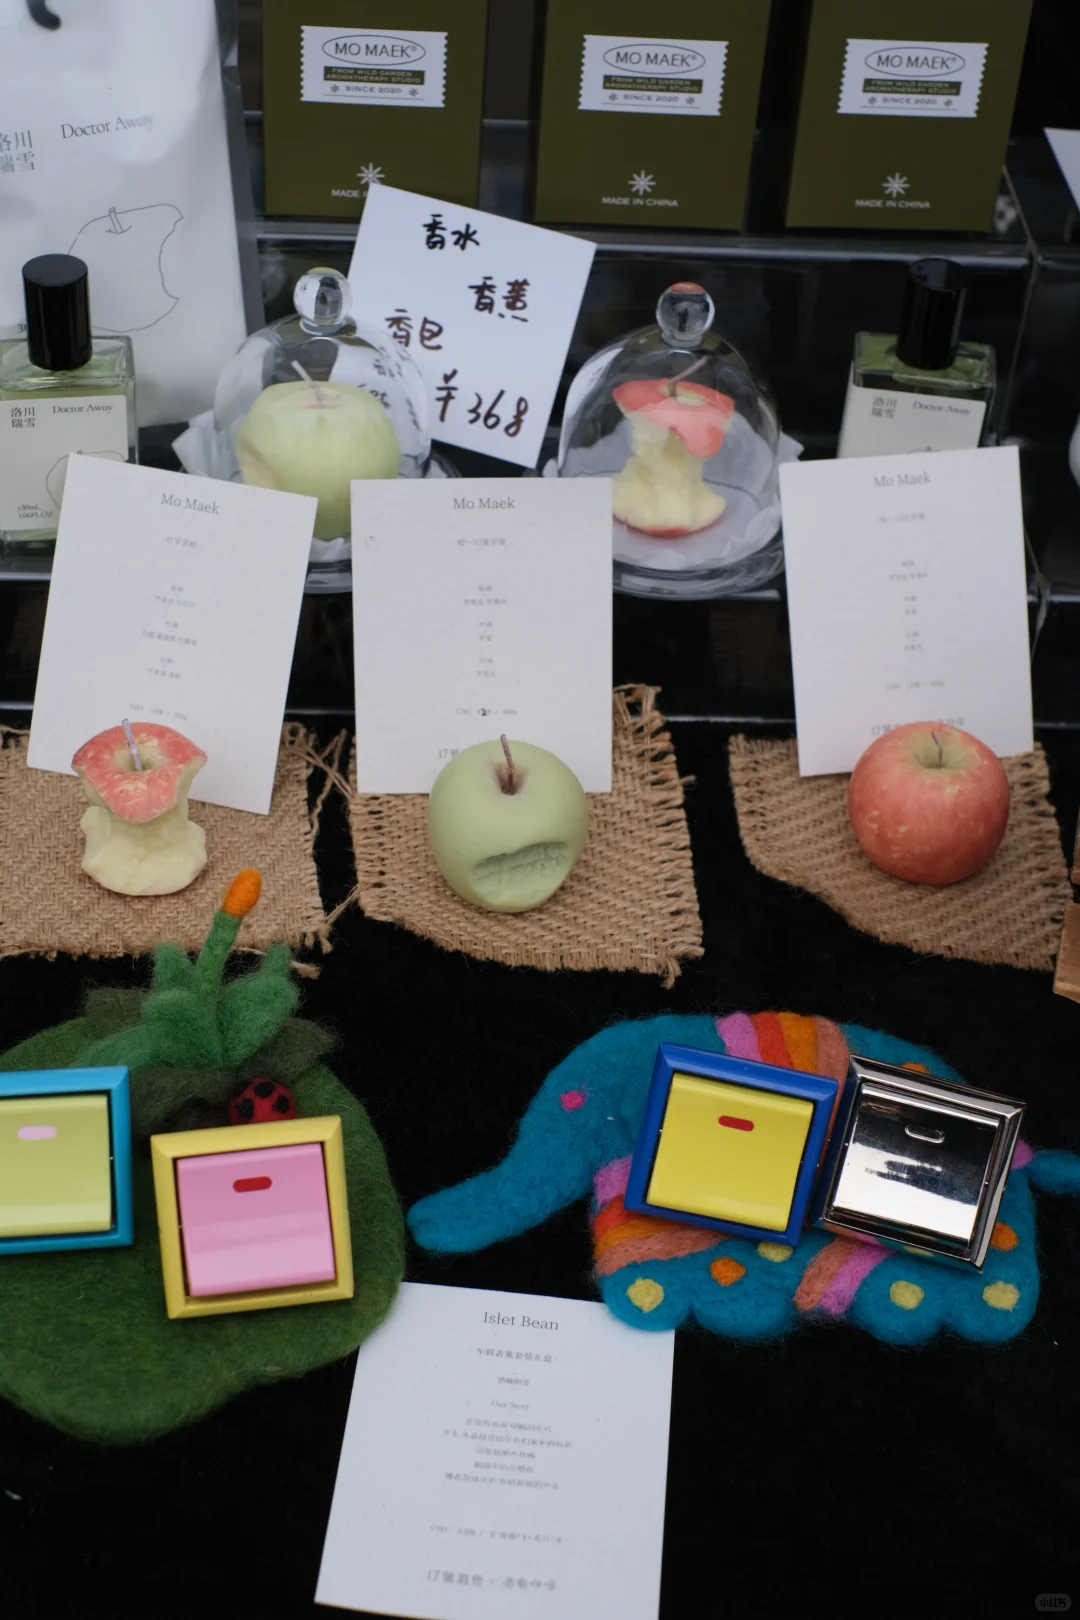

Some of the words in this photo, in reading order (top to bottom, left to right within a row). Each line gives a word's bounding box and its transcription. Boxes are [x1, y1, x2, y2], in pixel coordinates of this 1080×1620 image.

[334, 42, 361, 56] MO
[615, 51, 642, 65] MO
[877, 54, 903, 68] MO
[332, 67, 354, 75] FROM
[326, 74, 389, 82] AROMATHERAPY
[391, 76, 421, 84] STUDIO
[345, 85, 376, 93] SINCE
[378, 86, 402, 94] 2020
[623, 94, 653, 102] SINCE
[655, 95, 680, 103] 2020
[60, 121, 111, 139] Doctor
[331, 188, 361, 198] MADE
[601, 196, 631, 206] MADE
[632, 197, 644, 206] IN
[645, 198, 679, 208] CHINA
[855, 199, 883, 208] MADE
[423, 213, 480, 251] 香水
[385, 308, 444, 350] 香包
[10, 405, 36, 418] 洛川
[52, 404, 84, 414] Doctor
[86, 403, 113, 415] Away
[873, 474, 895, 488] Mo
[160, 492, 182, 508] Mo
[183, 497, 220, 515] Maek
[453, 497, 475, 510] Mo
[479, 495, 516, 510] Maek
[483, 1311, 516, 1326] Islet
[521, 1315, 559, 1331] Bean
